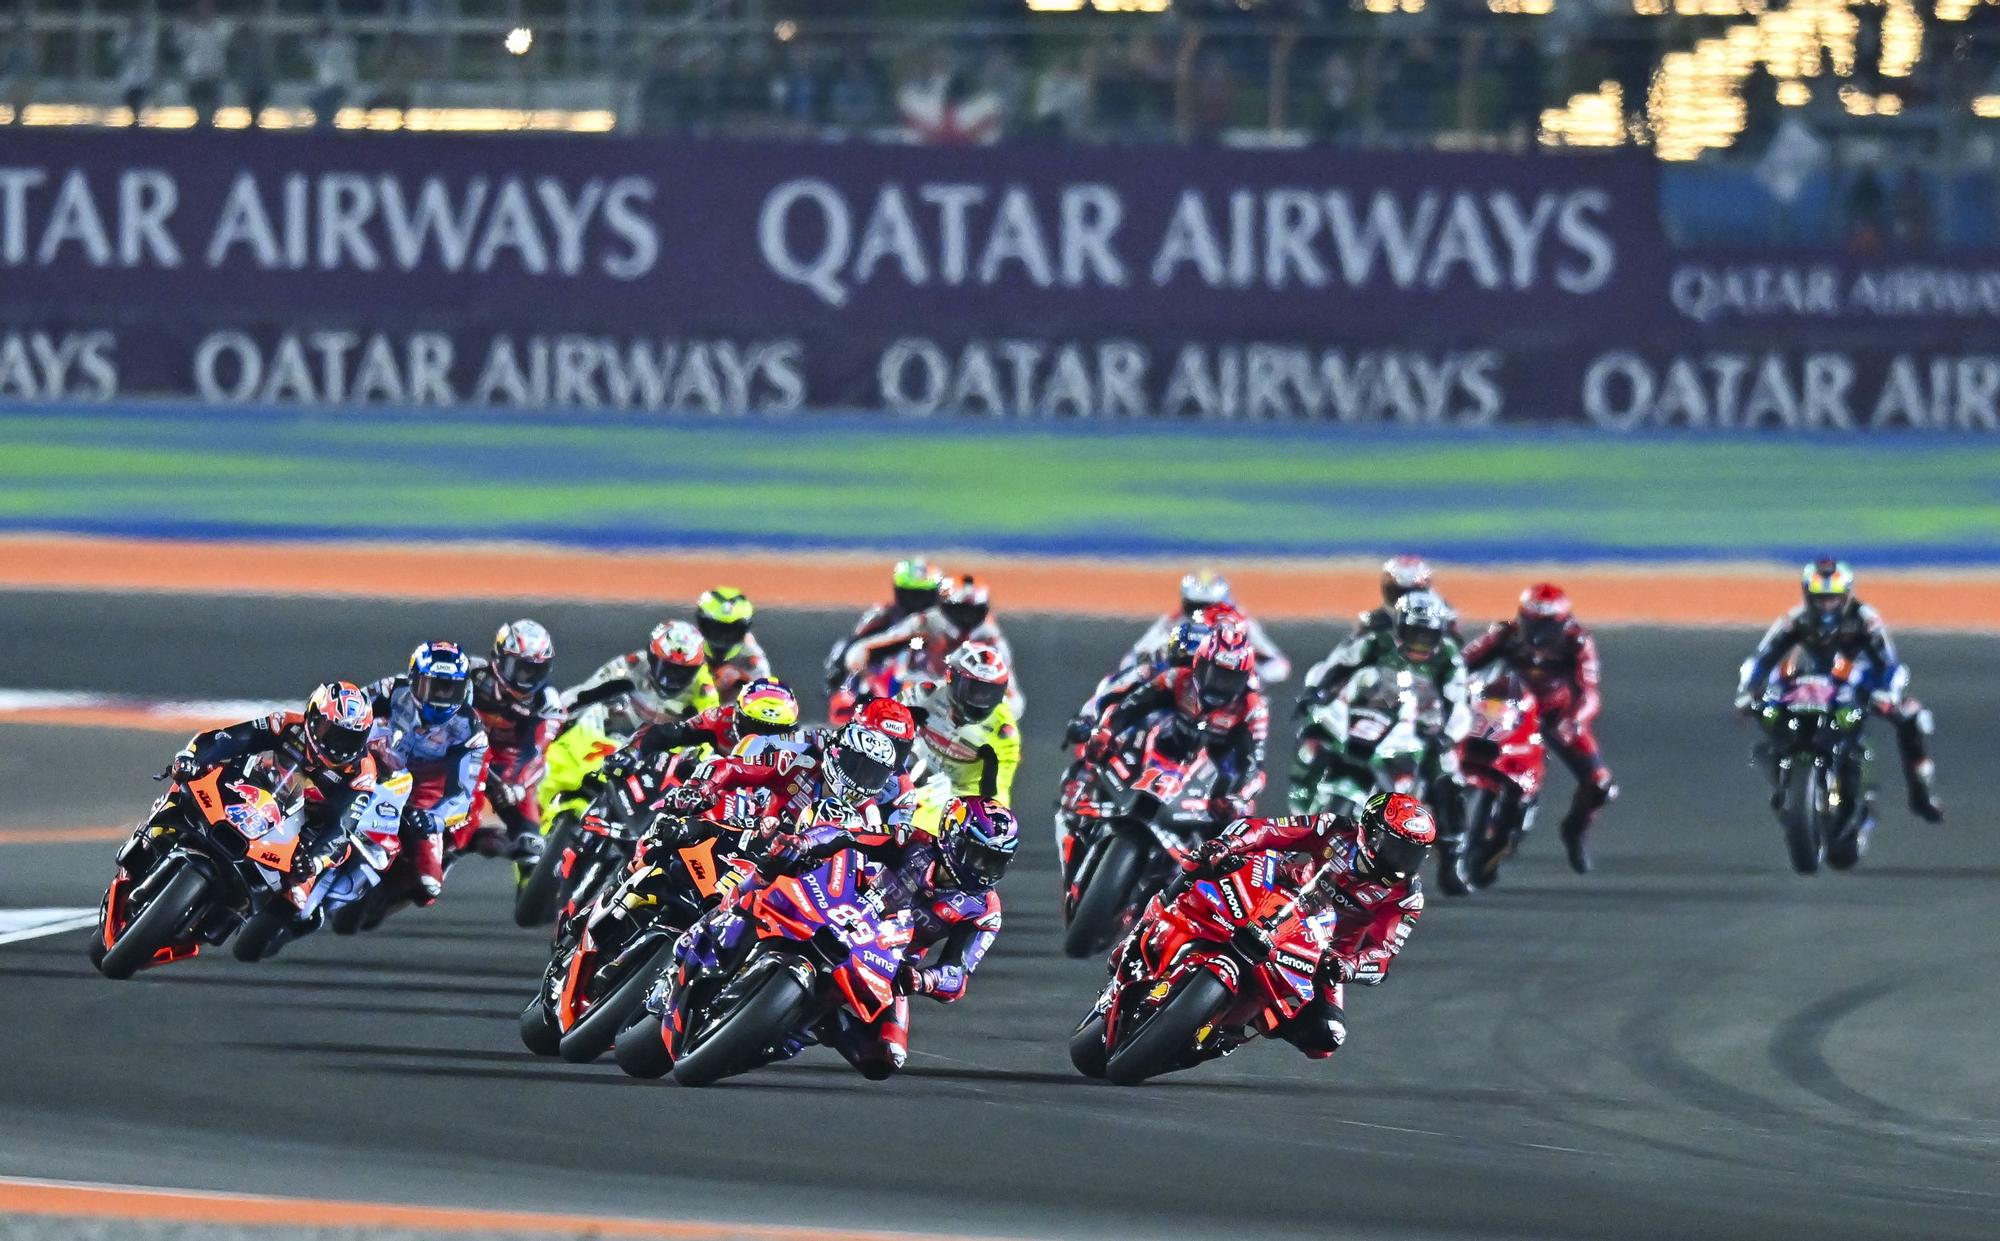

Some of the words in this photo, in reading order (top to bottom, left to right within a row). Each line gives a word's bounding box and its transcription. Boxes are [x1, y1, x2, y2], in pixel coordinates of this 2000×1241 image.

[0, 168, 182, 267] TAR
[207, 170, 659, 280] AIRWAYS
[759, 178, 1126, 306] QATAR
[1151, 188, 1617, 293] AIRWAYS
[1671, 266, 1838, 320] QATAR
[195, 331, 455, 403] QATAR
[472, 335, 806, 414] AIRWAYS
[878, 338, 1149, 417] QATAR
[1161, 345, 1502, 427] AIRWAYS
[1583, 351, 1853, 430] QATAR
[197, 790, 212, 809] KTM
[261, 851, 281, 865] KTM
[689, 859, 706, 880] KTM
[803, 873, 829, 910] prima
[1219, 878, 1243, 919] Lenovo
[827, 904, 875, 944] 89
[863, 950, 892, 973] prima
[1208, 958, 1237, 986] Lenovo
[1276, 951, 1314, 974] Lenovo
